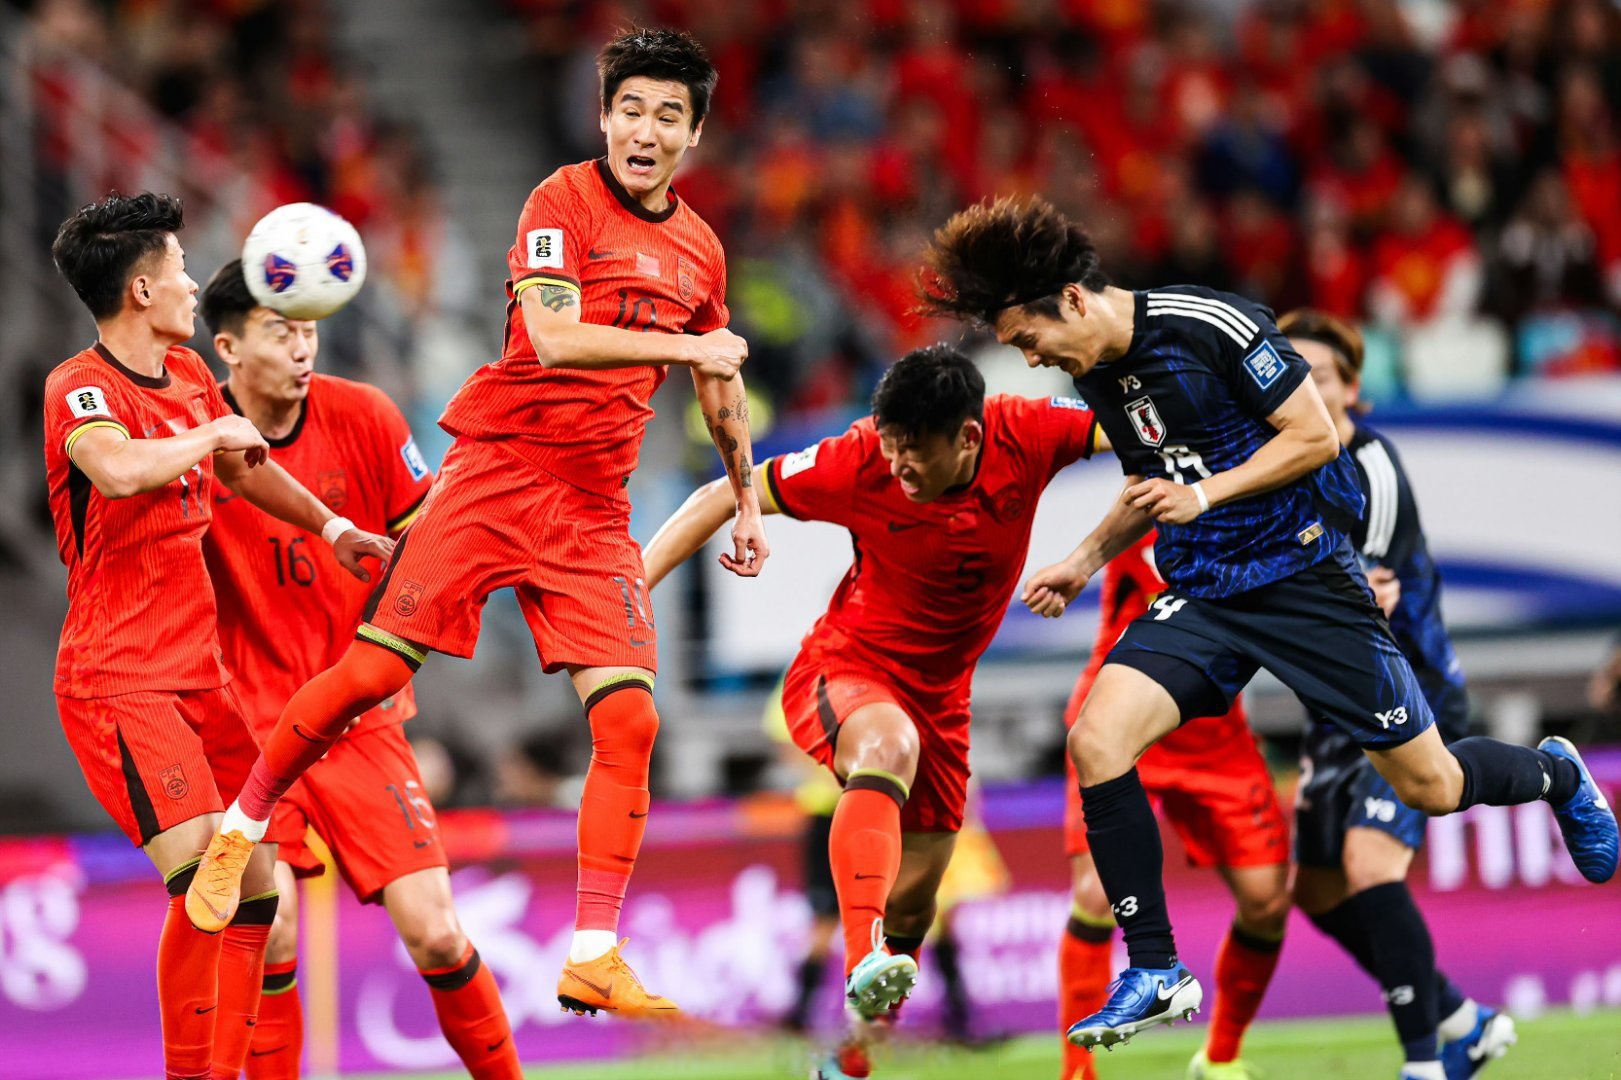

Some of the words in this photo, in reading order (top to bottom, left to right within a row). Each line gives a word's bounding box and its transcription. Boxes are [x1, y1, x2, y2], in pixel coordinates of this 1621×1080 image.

[1118, 375, 1142, 394] Y-3
[268, 537, 315, 587] 16
[955, 552, 990, 593] 5
[1374, 706, 1408, 729] Y-3
[385, 780, 434, 829] 16
